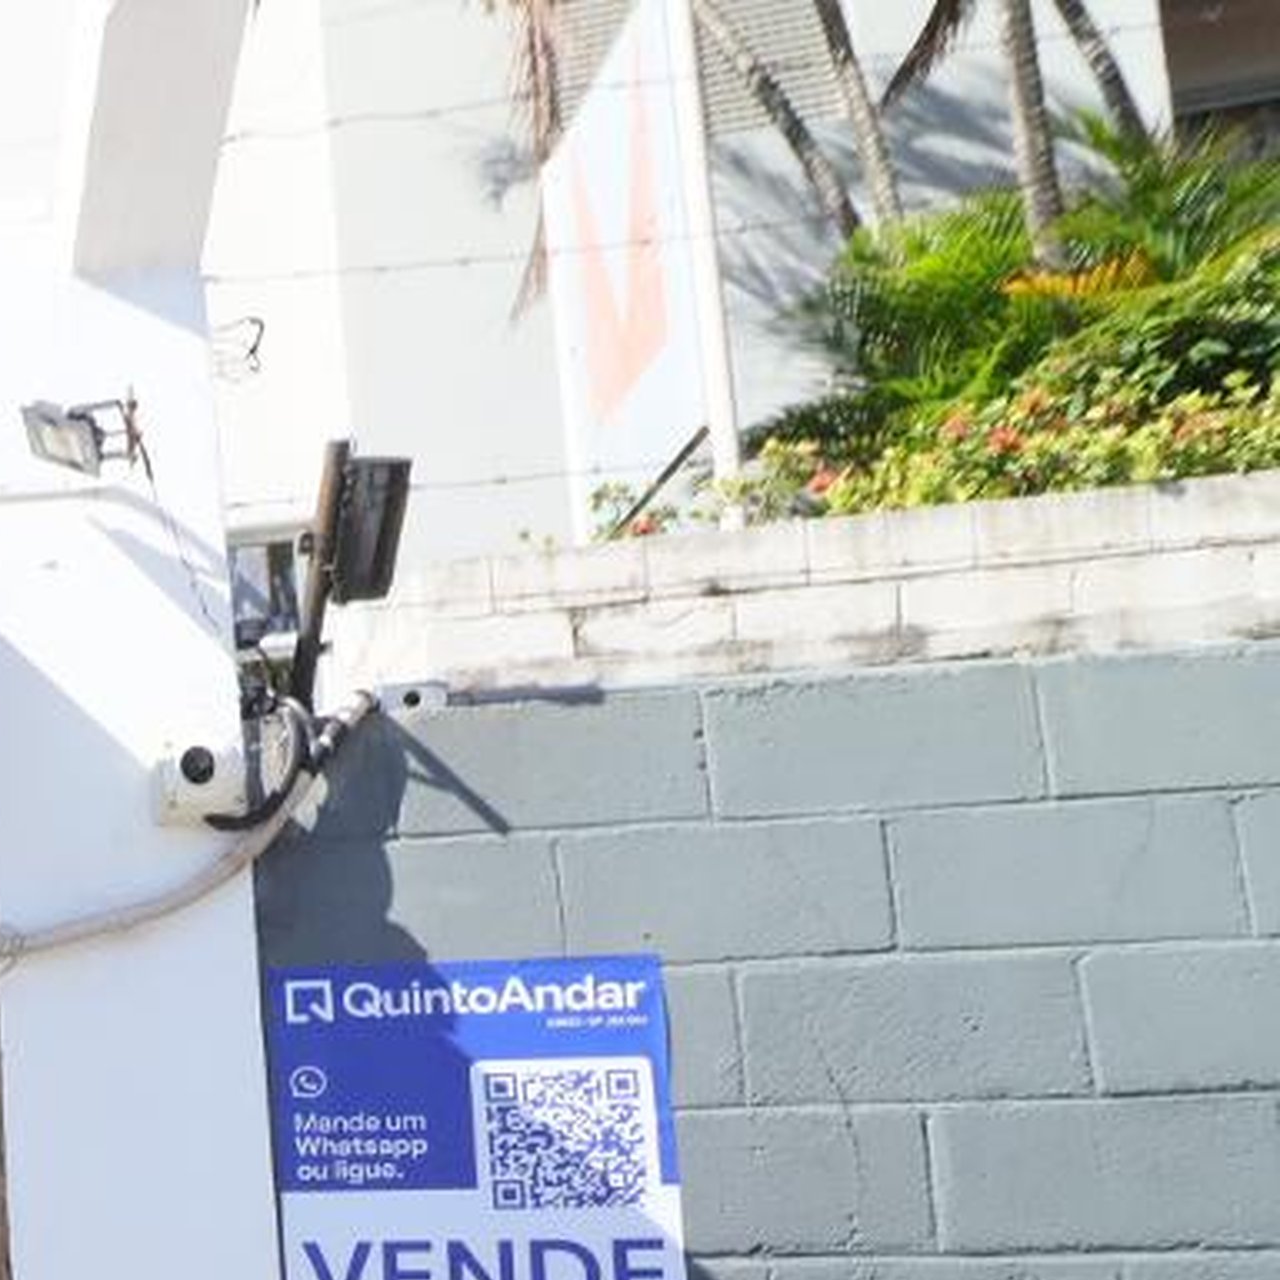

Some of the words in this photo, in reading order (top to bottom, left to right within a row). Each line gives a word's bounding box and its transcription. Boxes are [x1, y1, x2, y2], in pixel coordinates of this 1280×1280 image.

[342, 974, 646, 1019] QuintoAndar
[294, 1112, 381, 1134] Mande
[384, 1115, 427, 1132] um
[295, 1136, 428, 1159] Whatsapp
[297, 1164, 328, 1181] ou
[335, 1160, 405, 1184] ligue.
